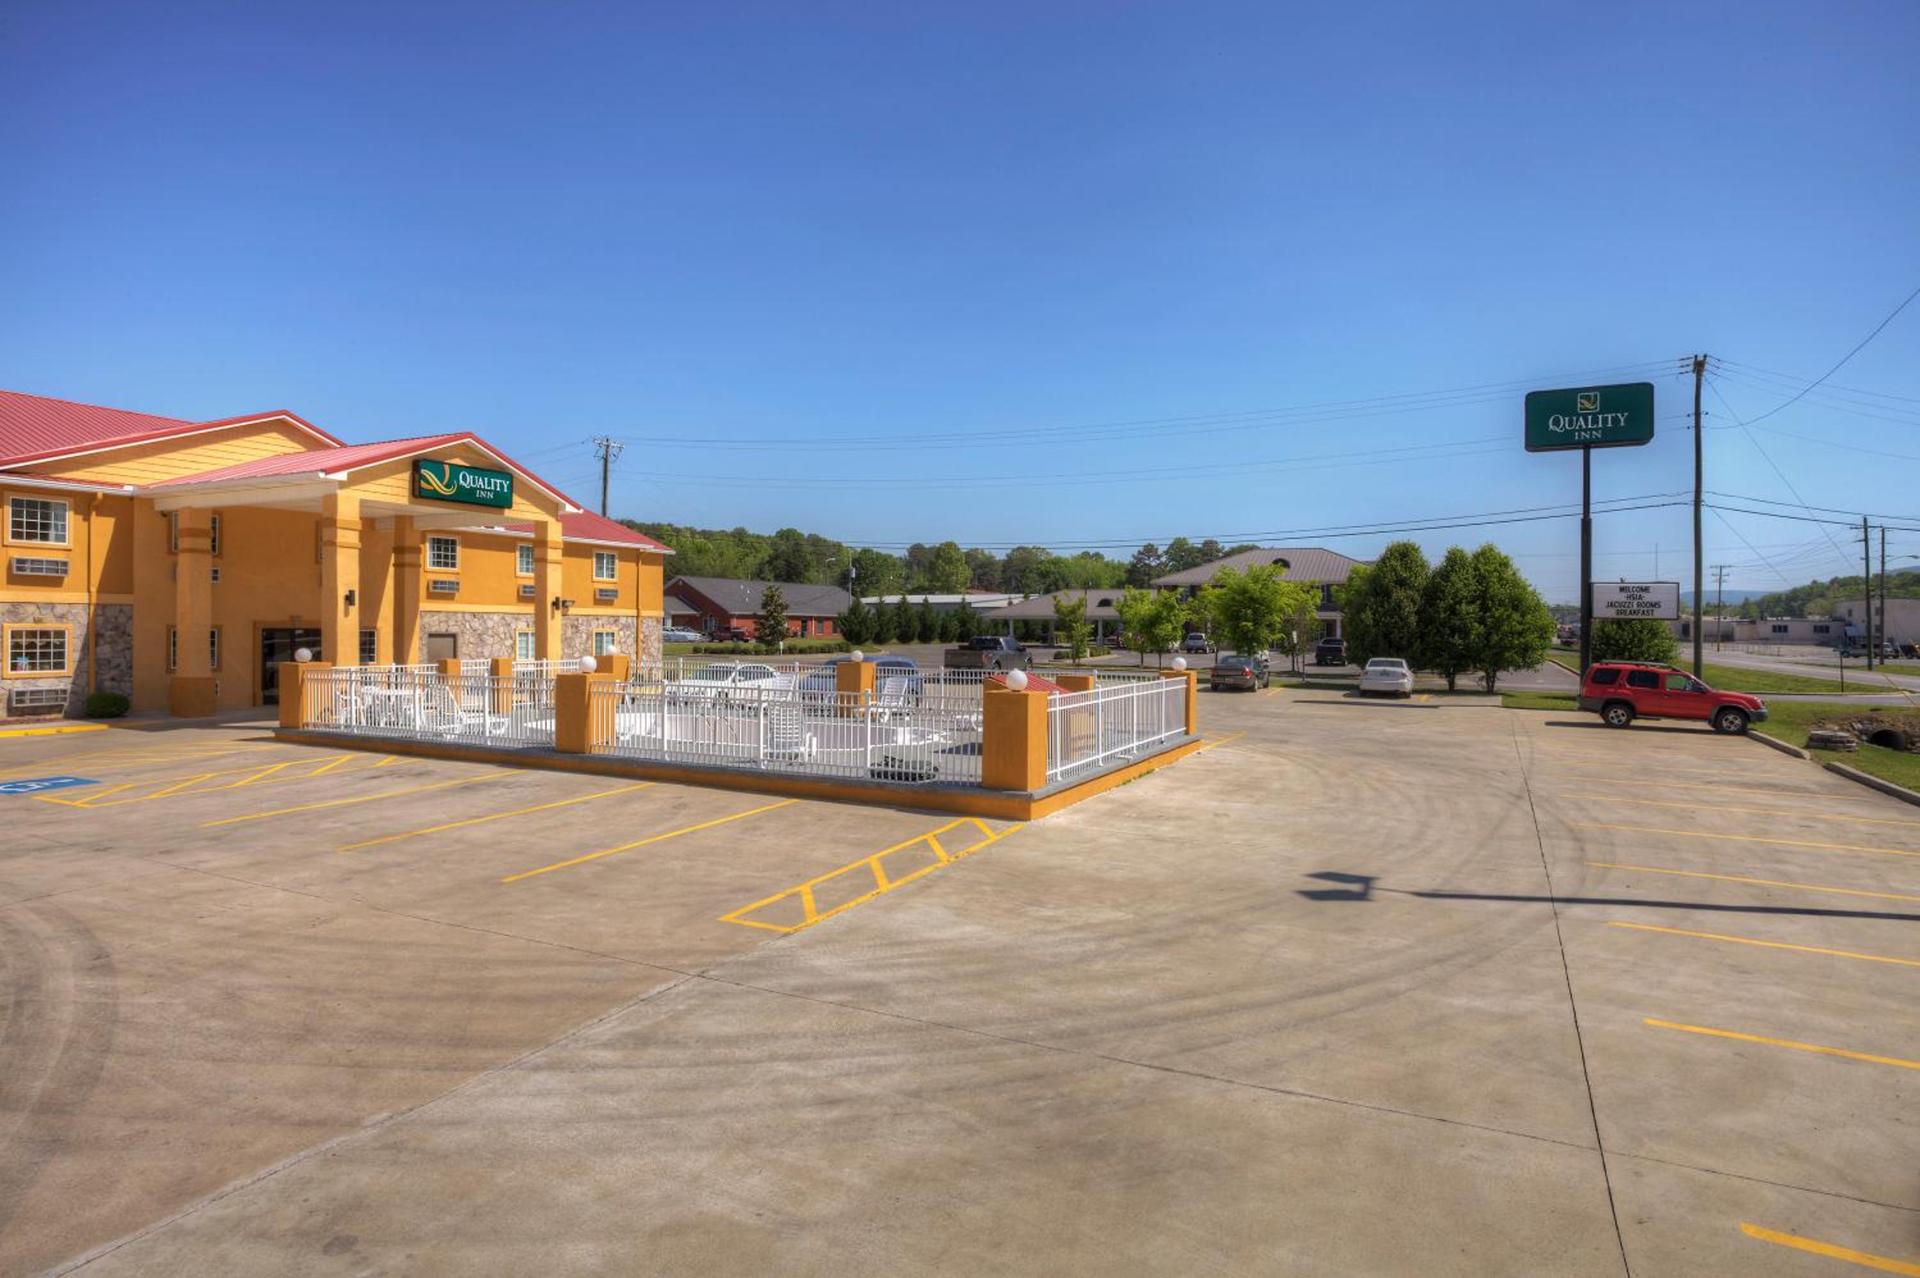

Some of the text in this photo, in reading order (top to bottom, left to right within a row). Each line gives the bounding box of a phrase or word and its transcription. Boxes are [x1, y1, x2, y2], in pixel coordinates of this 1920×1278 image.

[1548, 412, 1628, 433] QUALITY
[1575, 430, 1602, 441] INN
[459, 470, 510, 493] QUALITY
[476, 489, 494, 499] INN
[1619, 586, 1651, 594] WELCOME
[1606, 601, 1661, 609] JACUZZI ROOMS
[1616, 609, 1654, 617] BREAKFAST
